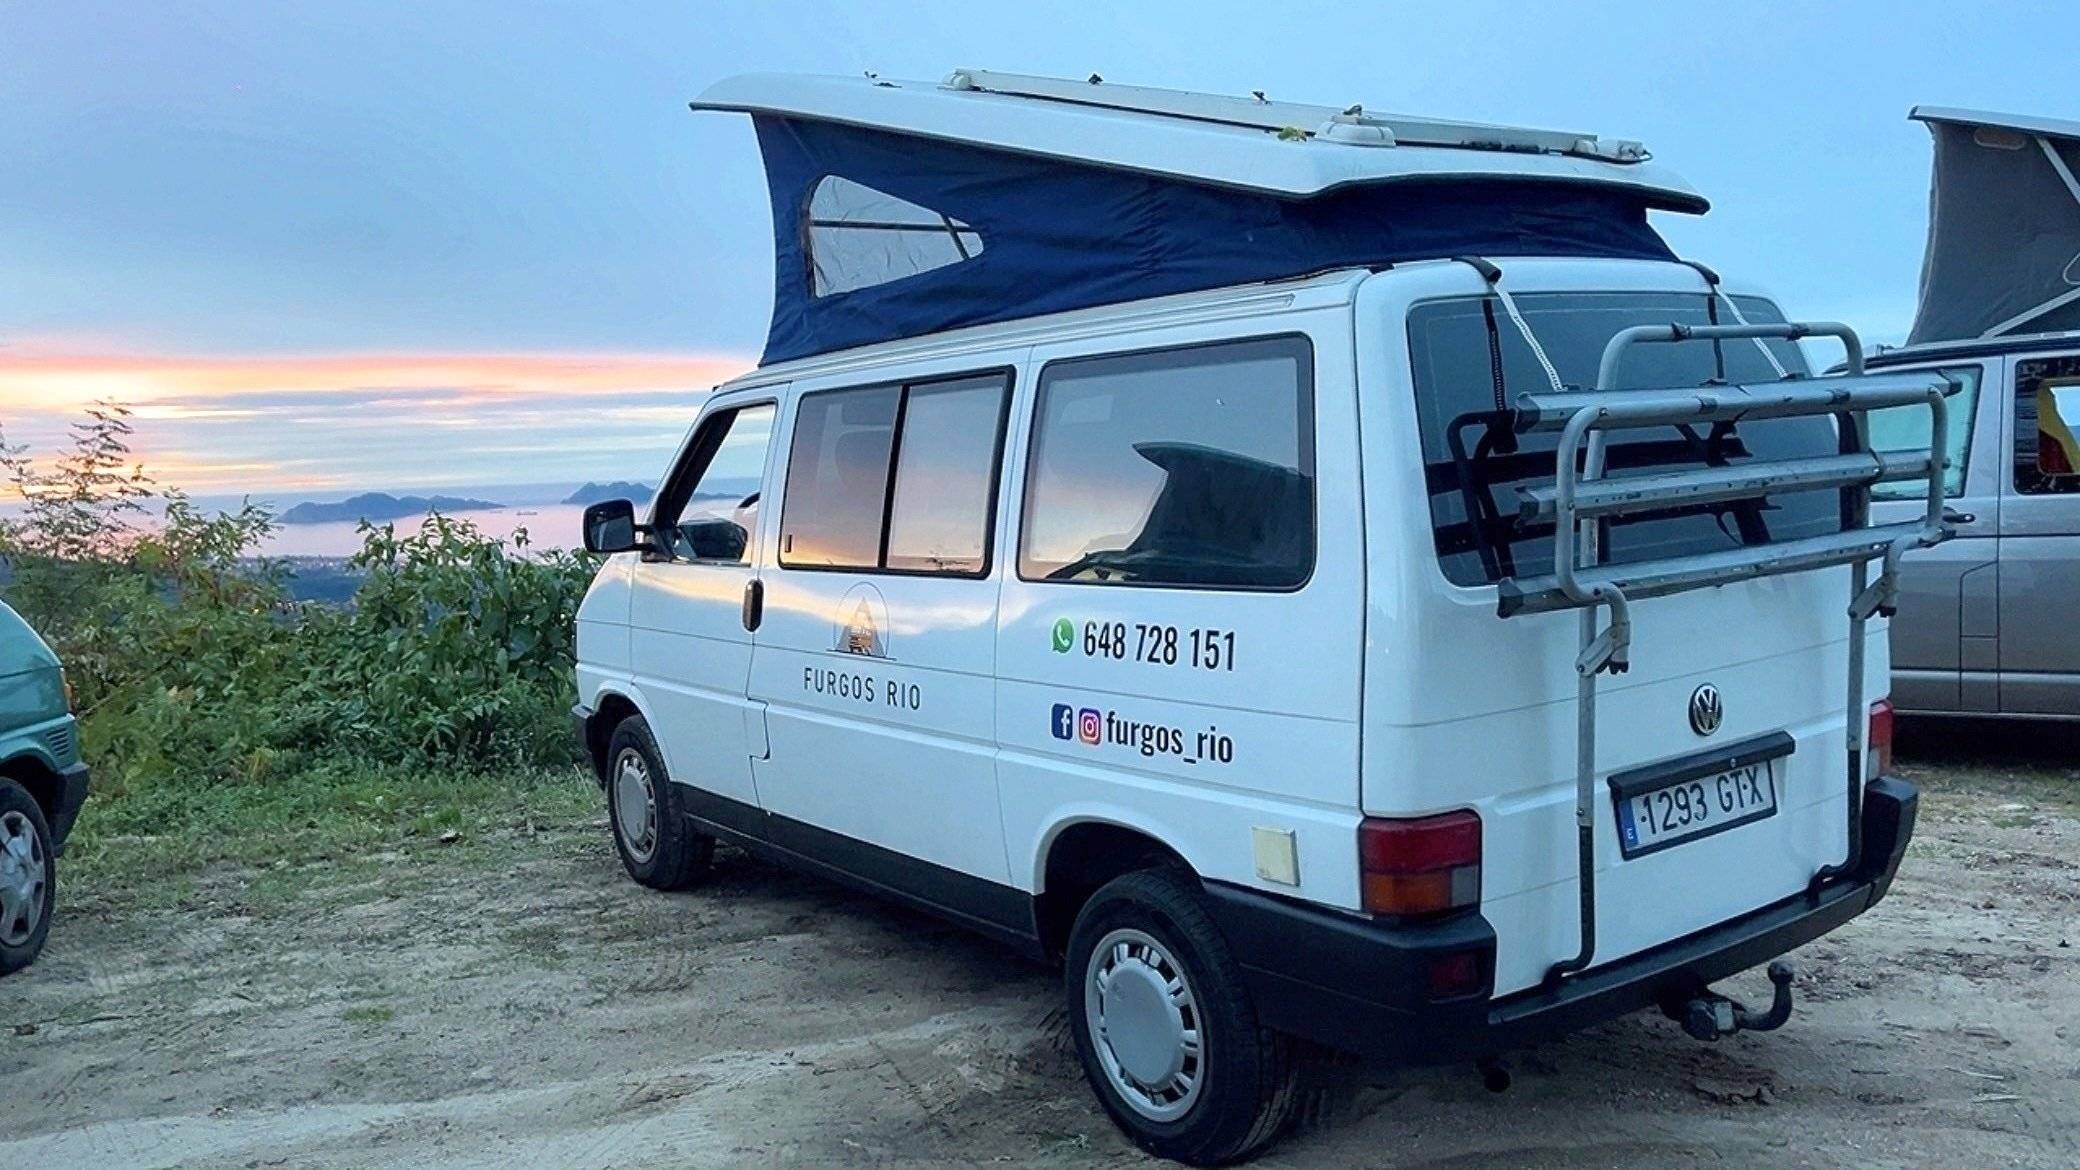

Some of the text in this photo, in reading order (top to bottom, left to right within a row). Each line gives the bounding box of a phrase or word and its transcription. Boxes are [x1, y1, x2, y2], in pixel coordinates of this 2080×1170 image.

[1083, 622, 1236, 672] 648 728 151
[803, 667, 921, 711] FURGOS RIO
[1106, 710, 1234, 763] furgos_rio
[1642, 766, 1764, 835] 1293 GTX
